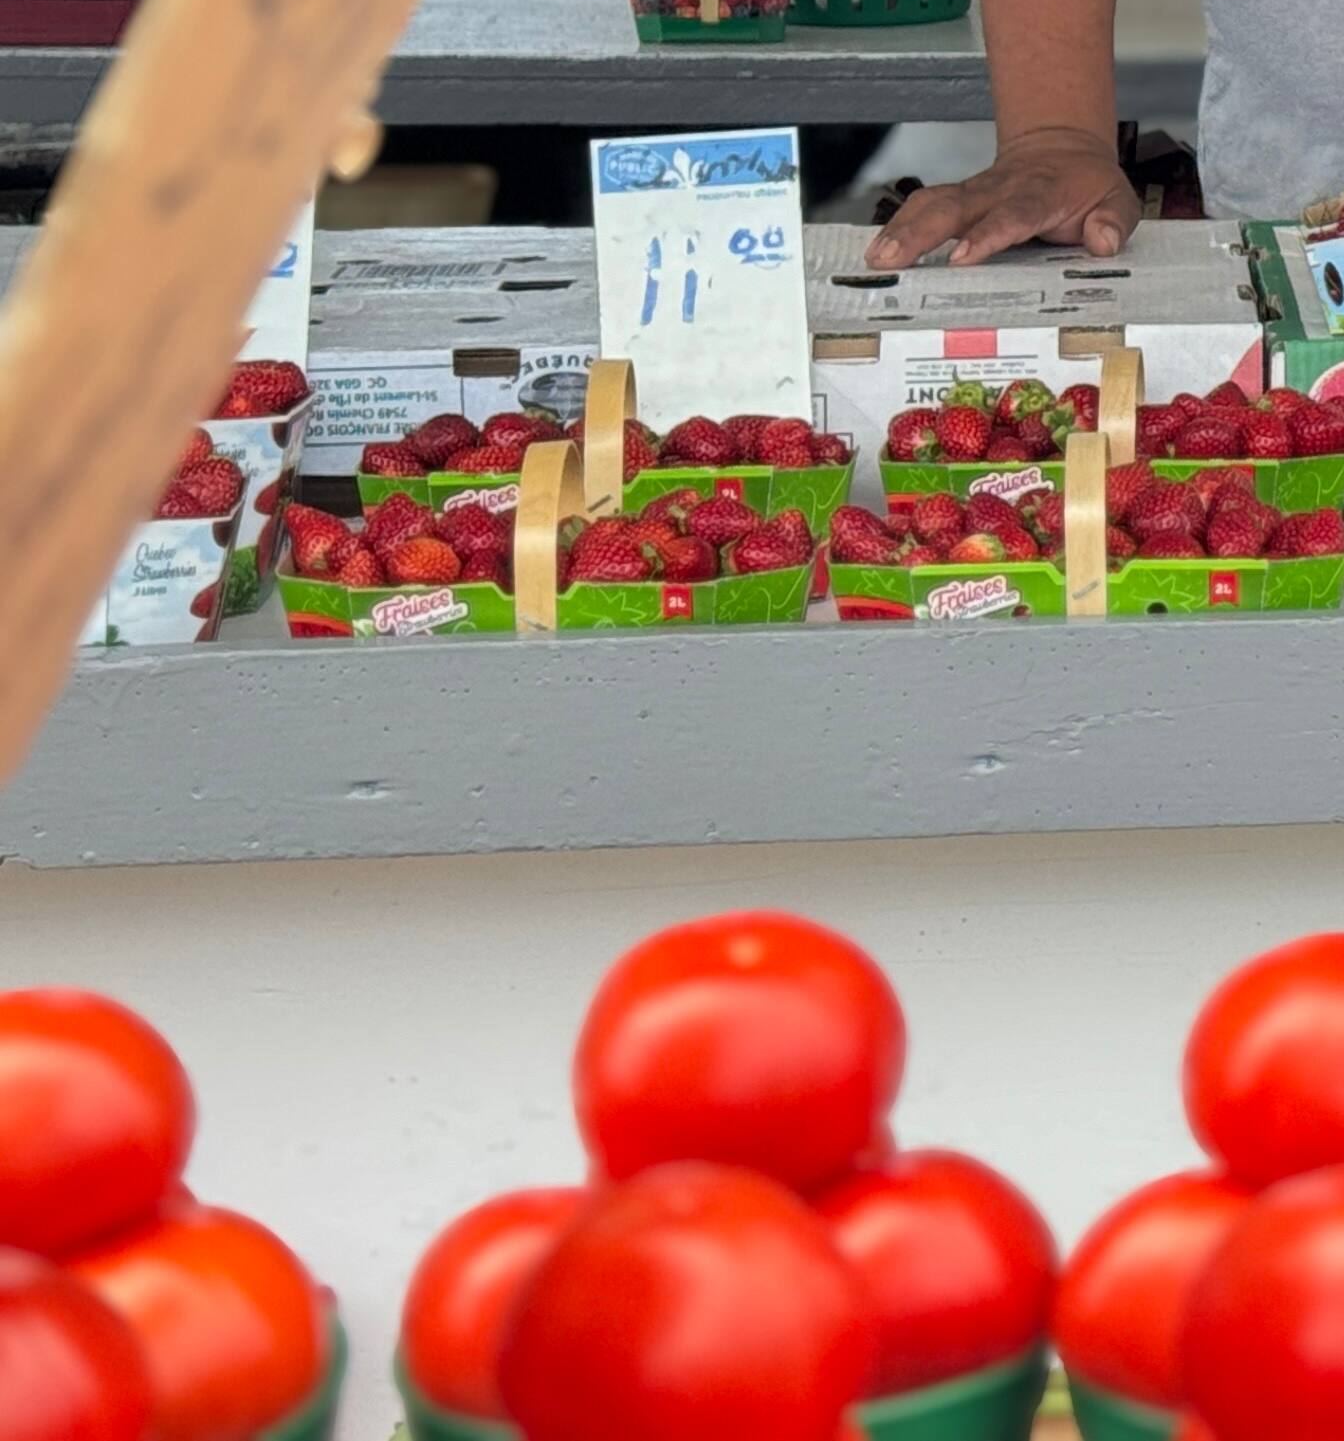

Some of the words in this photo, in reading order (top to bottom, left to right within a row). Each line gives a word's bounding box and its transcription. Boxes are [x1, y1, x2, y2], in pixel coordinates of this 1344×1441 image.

[931, 577, 1005, 617] Fraises
[1215, 584, 1233, 595] 2L
[373, 592, 451, 628] Fraises
[668, 596, 687, 608] 2L
